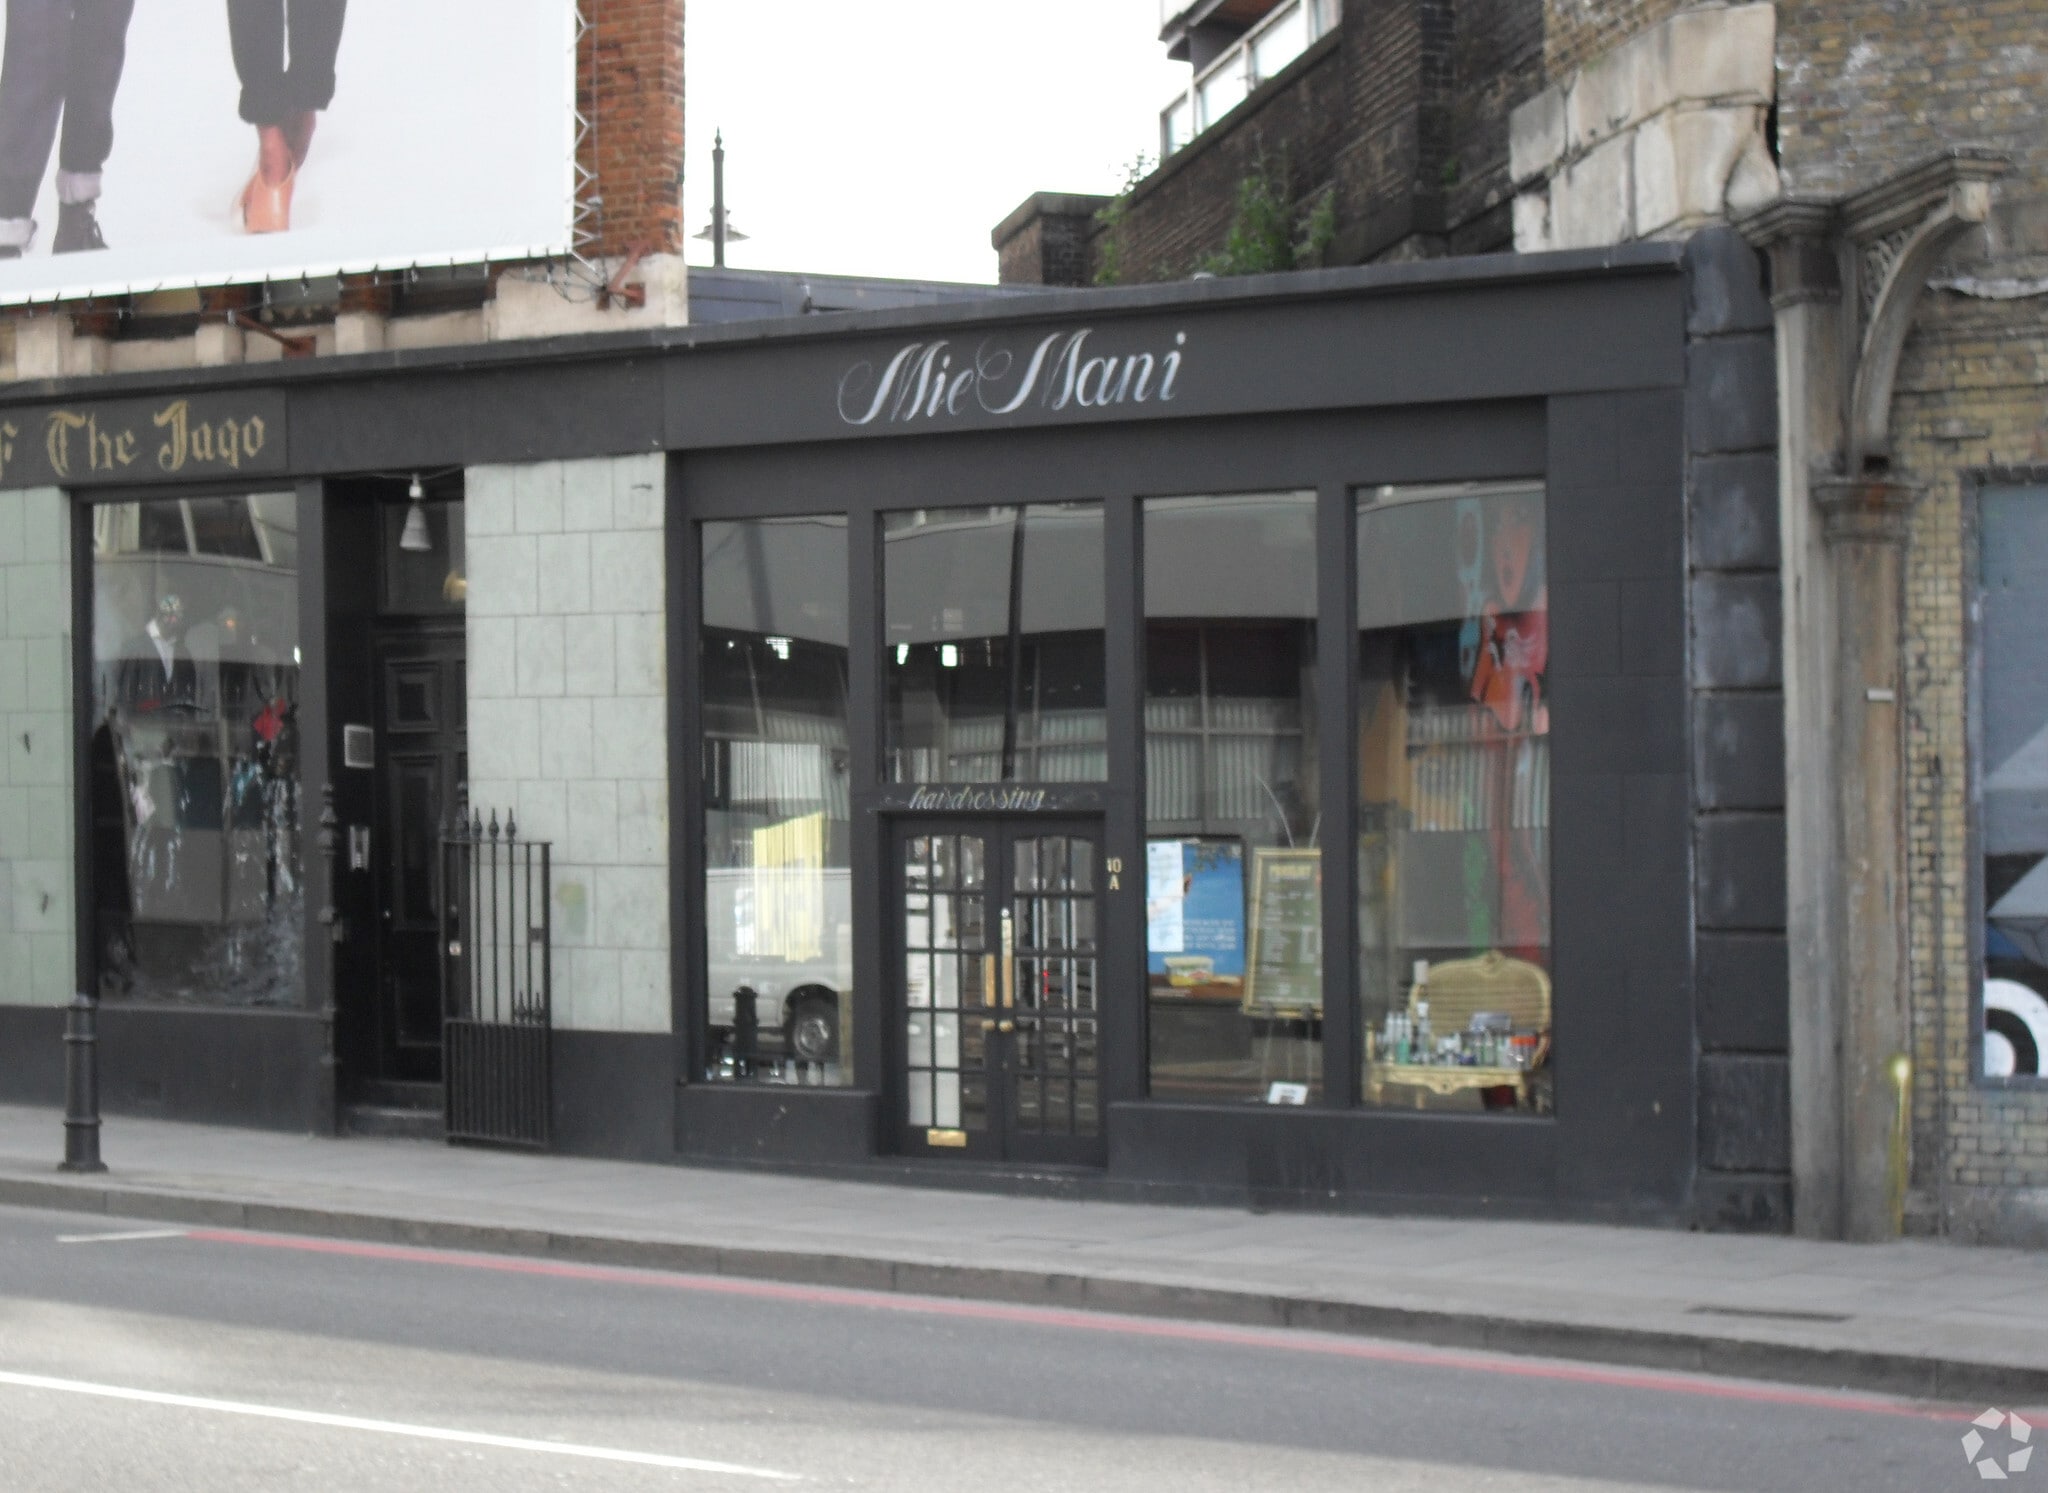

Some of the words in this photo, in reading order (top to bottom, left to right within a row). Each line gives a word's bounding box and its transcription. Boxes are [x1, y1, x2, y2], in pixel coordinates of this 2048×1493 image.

[838, 340, 974, 425] Mie
[976, 328, 1186, 413] Mani
[47, 410, 139, 477] The
[153, 400, 265, 472] Jago
[908, 785, 1046, 811] hairdressing
[1106, 857, 1122, 873] 10
[1109, 875, 1120, 890] A
